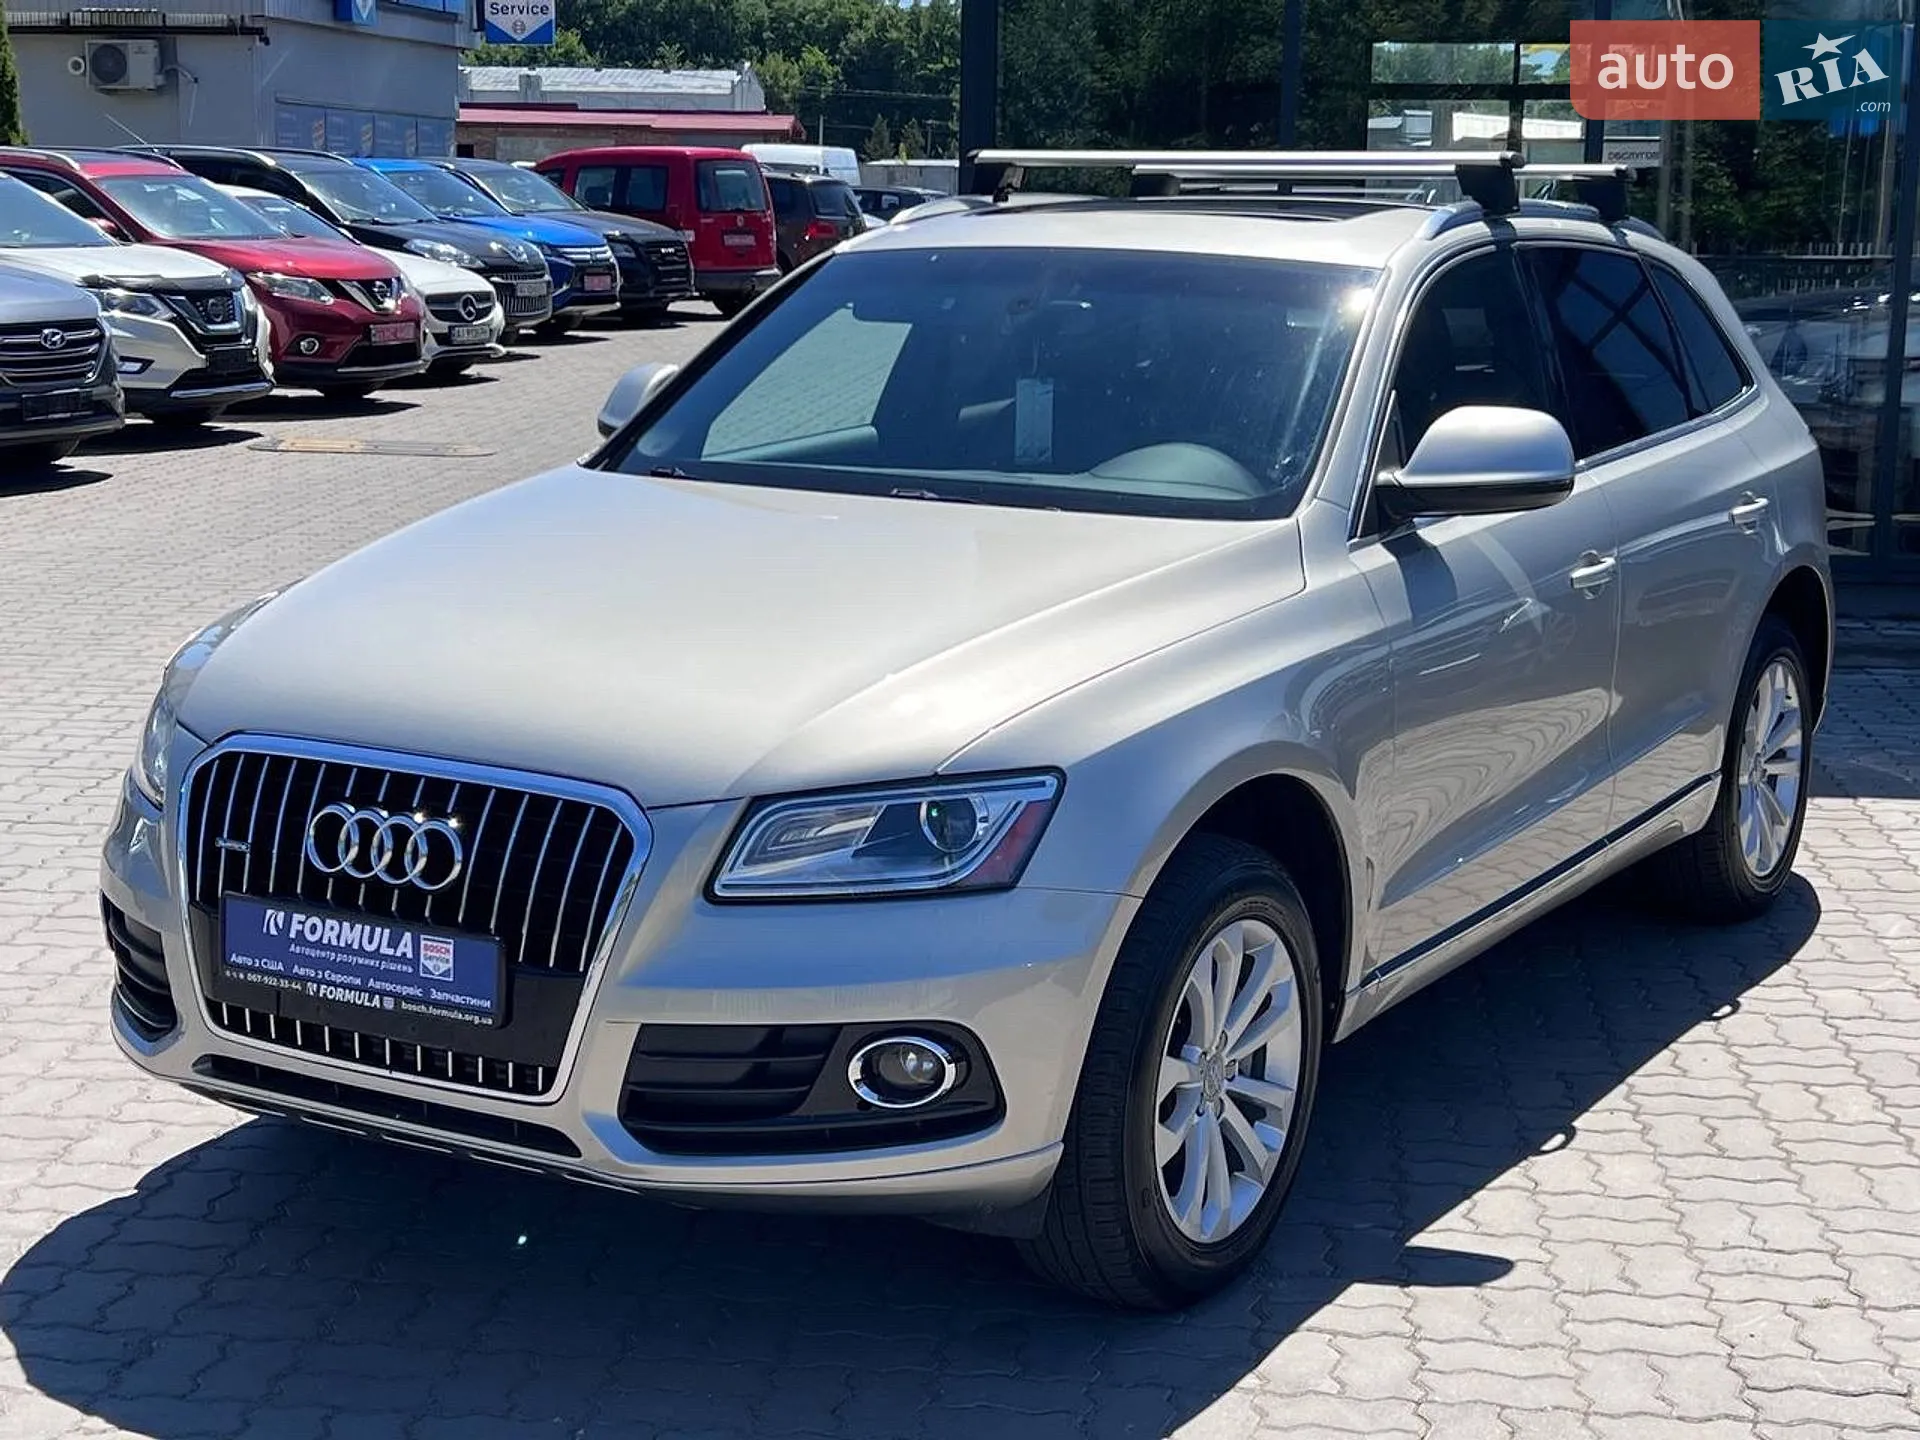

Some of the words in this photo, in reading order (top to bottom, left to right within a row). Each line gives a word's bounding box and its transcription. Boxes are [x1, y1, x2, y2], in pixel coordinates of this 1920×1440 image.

[490, 2, 549, 15] Service
[289, 912, 413, 959] FORMULA
[289, 943, 336, 961] Автоцентр
[336, 952, 381, 967] розумних
[380, 957, 414, 973] рішень
[423, 943, 450, 956] BOSCH
[423, 954, 450, 965] Service
[230, 953, 253, 965] Авто
[261, 958, 285, 971] США
[292, 964, 315, 978] Авто
[316, 970, 323, 978] з
[324, 970, 361, 986] Європи
[319, 984, 380, 1008] FORMULA
[367, 978, 424, 997] Автосервіс
[430, 988, 491, 1008] Запчастини
[401, 1001, 493, 1025] bosch.formula.org.ua
